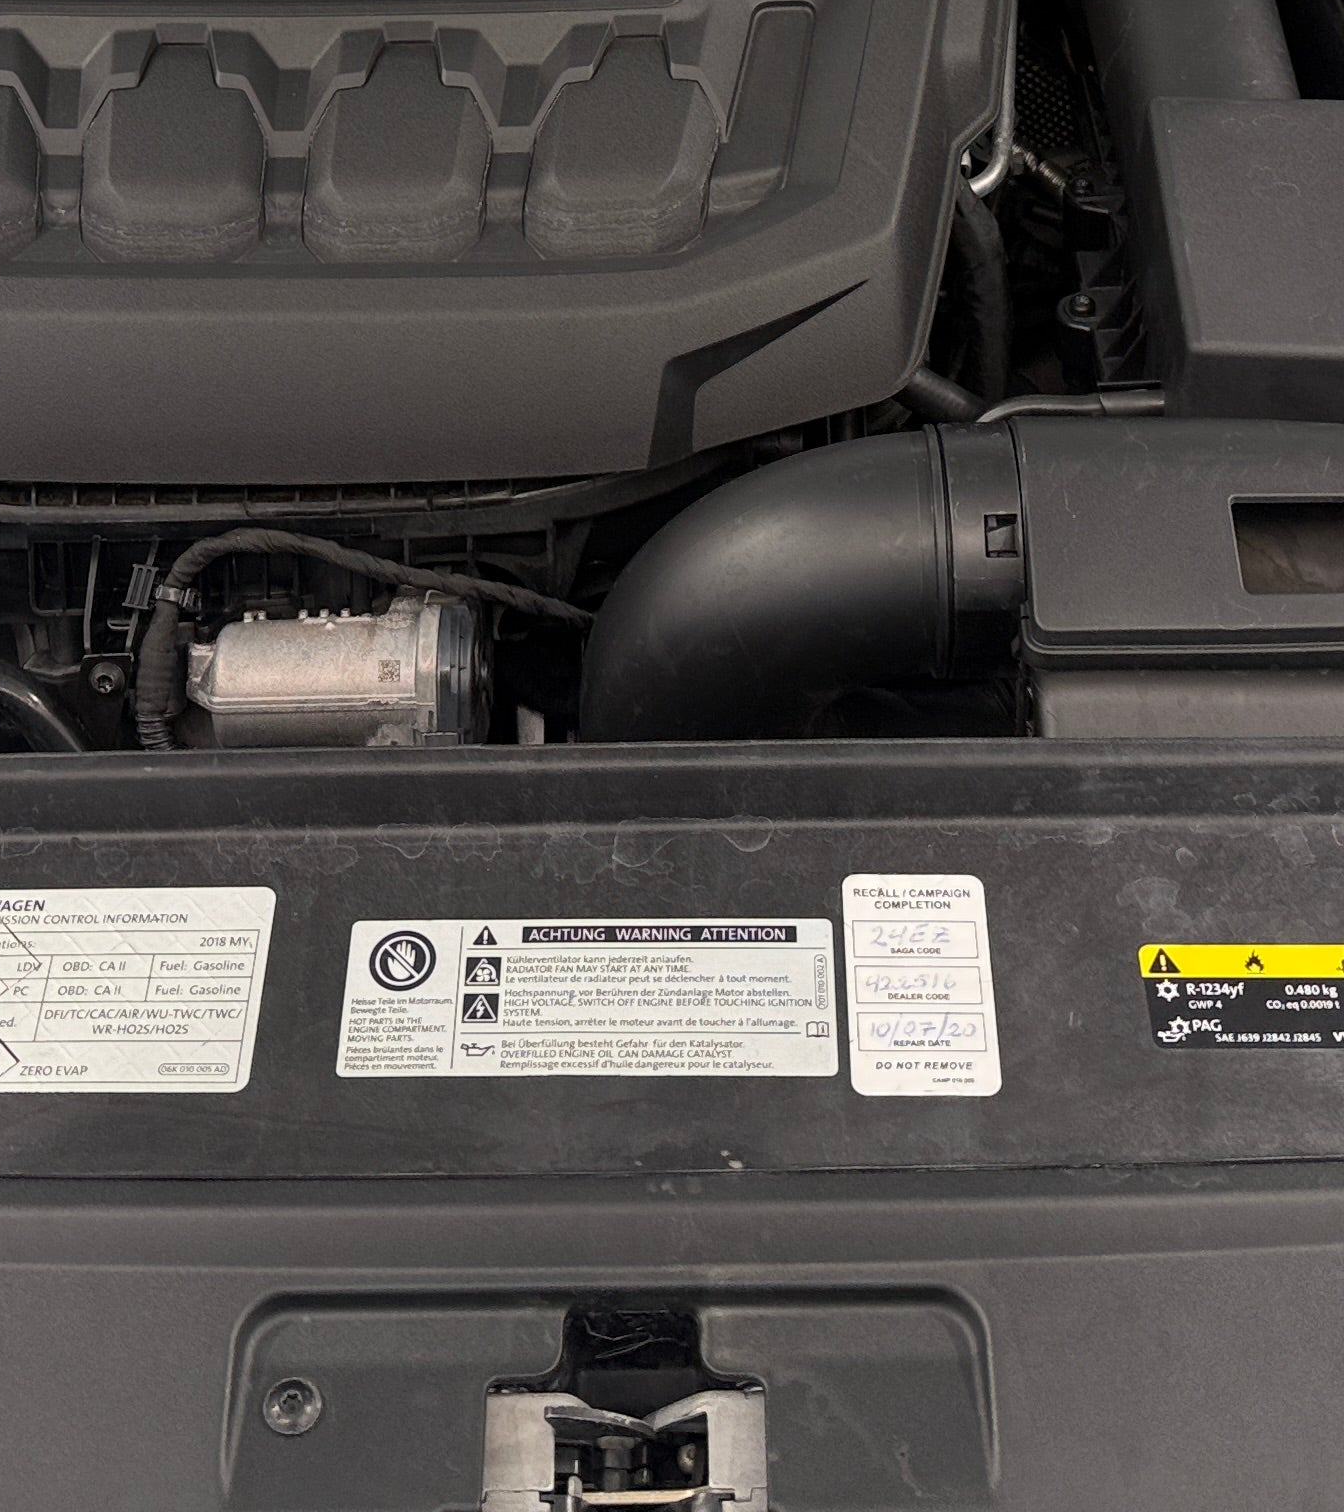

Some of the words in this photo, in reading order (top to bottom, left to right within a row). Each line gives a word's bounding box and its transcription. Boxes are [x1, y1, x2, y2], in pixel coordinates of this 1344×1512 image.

[853, 887, 900, 898] RECALL
[908, 888, 972, 899] CAMPAIGN
[873, 900, 952, 910] COMPLETION
[43, 914, 100, 925] CONTROL
[102, 913, 189, 924] INFORMATION
[528, 928, 606, 941] ACHTUNG
[615, 928, 692, 941] WARNING
[700, 927, 786, 941] ATTENTION
[199, 936, 228, 948] 2018
[916, 947, 941, 955] CODE
[583, 955, 606, 964] kann
[16, 962, 43, 972] LDV
[62, 961, 93, 972] OBD:
[98, 961, 117, 972] CA
[159, 961, 188, 972] Fuel:
[192, 961, 246, 972] Gasoline
[505, 965, 553, 974] RADIATOR
[554, 965, 574, 973] FAN
[575, 964, 598, 973] MAY
[599, 965, 628, 973] START
[629, 965, 641, 973] AT
[643, 964, 663, 973] ANY
[505, 976, 516, 984] Le
[517, 974, 569, 984] ventilateur
[569, 975, 582, 983] de
[583, 975, 627, 984] radiateur
[628, 975, 651, 985] peut
[726, 975, 747, 983] tout
[12, 986, 30, 996] PC
[57, 985, 89, 996] OBD:
[93, 985, 112, 996] CA
[154, 985, 183, 996] Fuel:
[189, 985, 241, 996] Gasoline
[640, 988, 656, 997] der
[714, 988, 745, 997] Motor
[1185, 982, 1246, 999] R-1234yf
[1285, 983, 1321, 996] 0.480
[1321, 983, 1338, 999] kg
[887, 992, 924, 1001] DEALER
[925, 992, 951, 1001] CODE
[503, 998, 530, 1007] HIGH
[577, 998, 615, 1007] SWITCH
[616, 998, 636, 1007] OFF
[637, 998, 674, 1007] ENGINE
[675, 998, 712, 1007] BEFORE
[714, 998, 766, 1007] TOUCHING
[767, 998, 813, 1007] IGNITION
[1188, 1000, 1214, 1010] GWP
[1215, 1000, 1223, 1010] 4
[1286, 1001, 1299, 1011] eq
[368, 1017, 393, 1025] PARTS
[502, 1018, 533, 1027] Haute
[608, 1018, 617, 1026] le
[619, 1019, 655, 1027] moteur
[656, 1018, 683, 1027] avant
[685, 1017, 697, 1027] de
[699, 1017, 736, 1027] toucher
[1191, 1019, 1223, 1032] PAG
[893, 1039, 927, 1047] REPAIR
[927, 1039, 952, 1047] DATE
[1214, 1033, 1235, 1043] SAE
[501, 1039, 516, 1049] Bei
[577, 1039, 614, 1048] besteht
[616, 1039, 649, 1048] Gefahr
[668, 1039, 687, 1048] den
[500, 1049, 557, 1059] OVERFILLED
[558, 1049, 596, 1059] ENGINE
[597, 1049, 614, 1058] OIL
[617, 1049, 639, 1058] CAN
[641, 1050, 685, 1059] DAMAGE
[19, 1064, 53, 1076] ZERO
[55, 1064, 89, 1076] EVAP
[499, 1060, 559, 1071] Remplissage
[634, 1060, 686, 1071] dangereux
[687, 1060, 710, 1071] pour
[712, 1059, 721, 1069] le
[875, 1061, 893, 1071] DO
[895, 1061, 919, 1071] NOT
[923, 1061, 974, 1071] REMOVE
